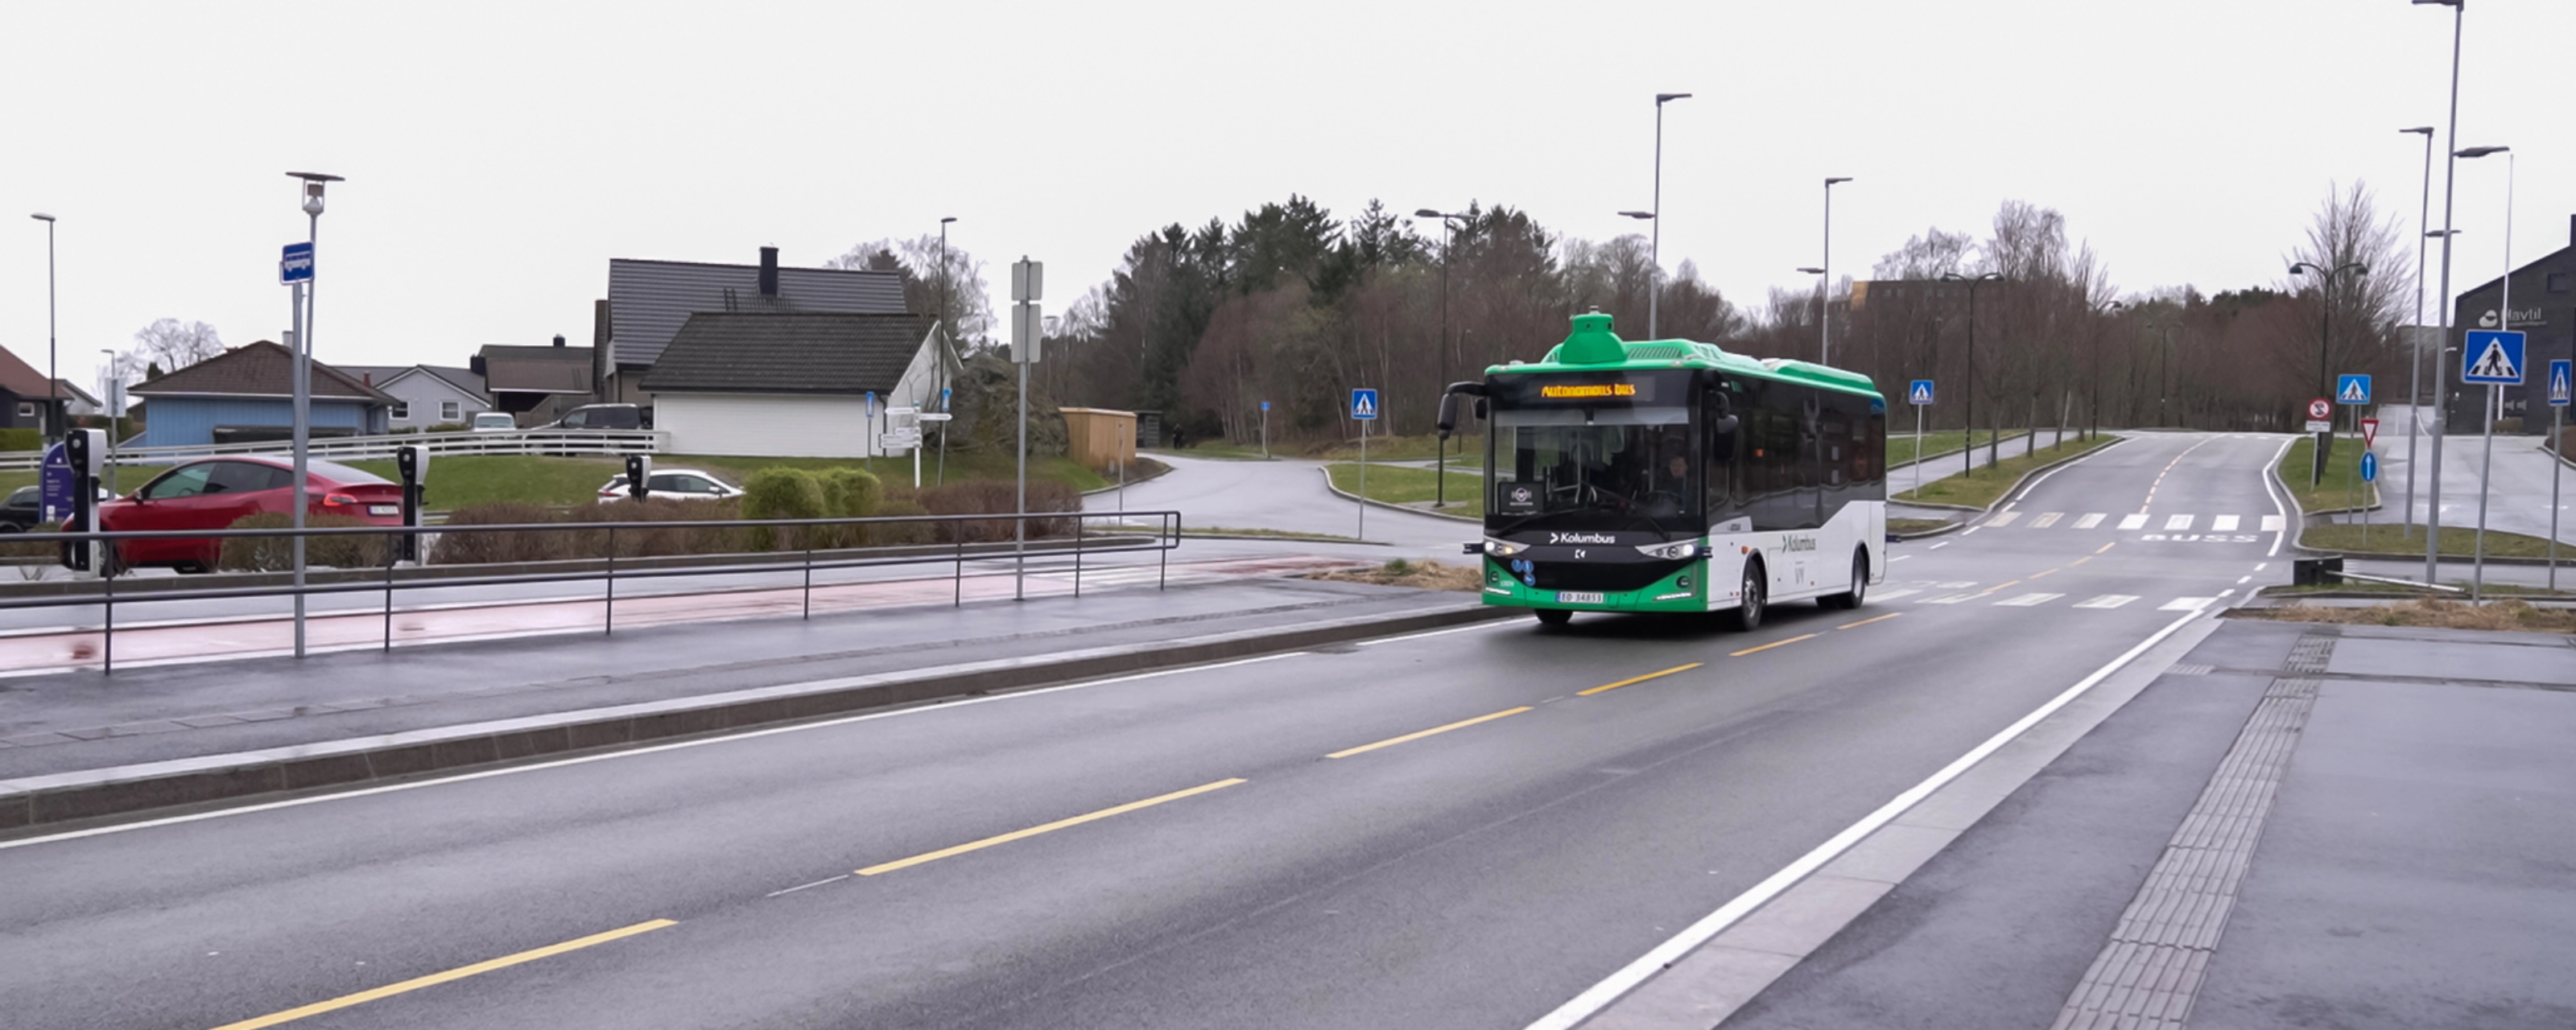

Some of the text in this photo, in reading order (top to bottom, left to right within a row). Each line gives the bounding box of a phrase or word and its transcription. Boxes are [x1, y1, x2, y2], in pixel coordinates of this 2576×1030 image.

[2500, 307, 2541, 321] Havtil
[1561, 532, 1616, 544] Kolumbus
[2140, 534, 2260, 543] BUSS
